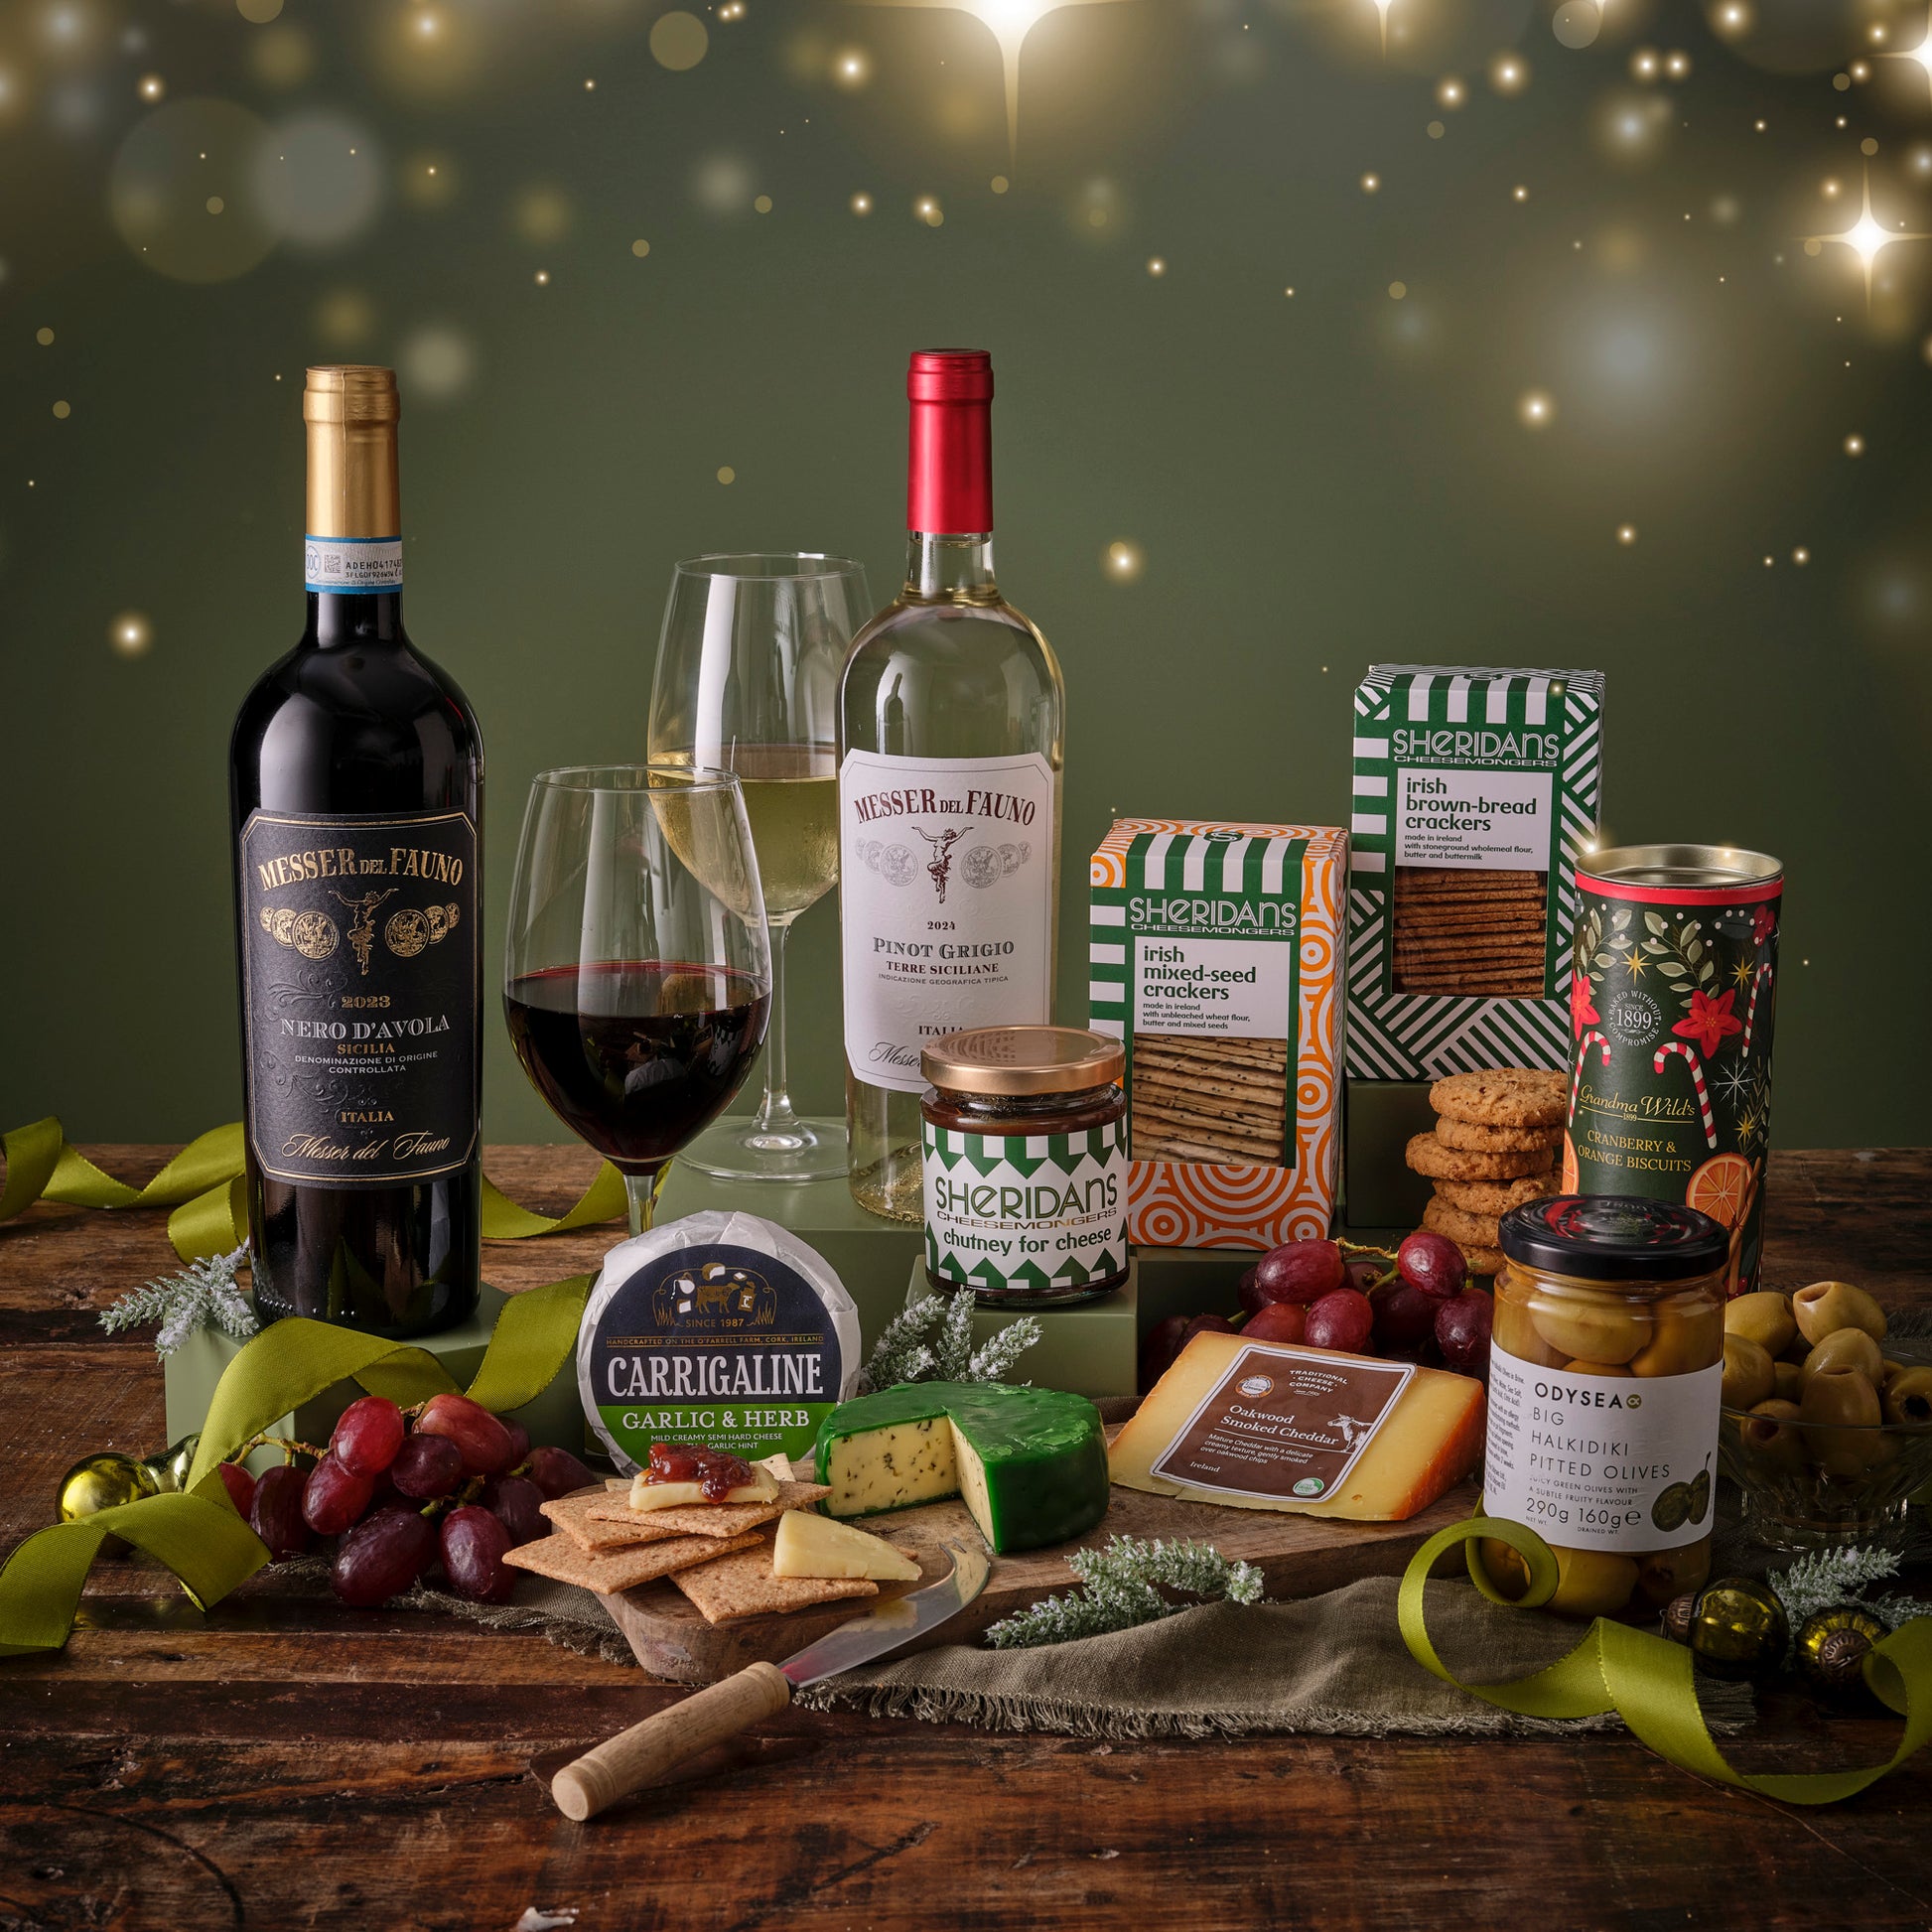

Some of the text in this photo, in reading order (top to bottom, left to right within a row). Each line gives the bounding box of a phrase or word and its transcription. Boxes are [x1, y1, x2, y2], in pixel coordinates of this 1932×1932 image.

[1394, 756, 1558, 767] CHEESEMONGERS
[1406, 776, 1447, 794] irish
[854, 789, 1035, 826] MESSER DEL FAUNO
[1406, 794, 1537, 815] brown-bread
[1405, 813, 1491, 831] crackers
[1423, 843, 1469, 852] stoneground
[257, 847, 463, 891] MESSER DEL FAUNO
[927, 921, 956, 930] 2024
[1131, 923, 1295, 936] CHEESEMONGERS
[873, 937, 1014, 960] PINOT GRIGIO
[1144, 945, 1184, 963] irish
[886, 961, 998, 975] TERRE SICILIANE
[1144, 964, 1256, 983] mixed-seed
[878, 973, 926, 984] INDICAZIONE
[984, 976, 1009, 984] TIPICA
[1143, 982, 1230, 1000] crackers
[341, 995, 391, 1008] 2023
[1631, 990, 1662, 1021] WITHOUT
[280, 1014, 450, 1039] NERO D'AVOLA
[1617, 1009, 1652, 1030] 1899
[1609, 1022, 1659, 1046] COMPROMISE
[295, 1055, 382, 1065] DENOMINAZIONE
[399, 1051, 438, 1062] ORIGINE
[337, 1043, 396, 1055] SICILIA
[869, 1041, 921, 1068] Messe
[329, 1065, 407, 1074] CONTROLLATA
[1580, 1084, 1696, 1116] Grandma Wild's
[341, 1111, 395, 1122] ITALIA
[281, 1130, 450, 1160] Messer del Fauno
[1587, 1129, 1677, 1153] CRANBERRY &
[1578, 1145, 1692, 1172] ORANGE BISCUITS
[937, 1207, 1117, 1230] CHEESEMONGERS
[943, 1228, 1111, 1256] chutney for cheese
[685, 1317, 745, 1328] SINCE 1987
[607, 1337, 663, 1346] HANDCRAFTED
[791, 1334, 824, 1343] IRELAND
[608, 1354, 824, 1397] CARRIGALINE
[1289, 1370, 1348, 1384] TRADITIONAL
[1297, 1376, 1334, 1386] CHEESE
[1289, 1381, 1334, 1393] COMPANY
[1534, 1382, 1623, 1409] ODYSEA
[622, 1410, 810, 1430] GARLIC & HERB
[1230, 1405, 1295, 1424] Oakwood
[1533, 1407, 1565, 1426] BIG
[1220, 1415, 1339, 1445] Smoked Cheddar
[1204, 1440, 1231, 1450] creamy
[1257, 1451, 1280, 1461] gently
[1280, 1454, 1309, 1464] smoked
[1208, 1434, 1234, 1444] Mature
[1234, 1439, 1263, 1450] Cheddar
[1285, 1449, 1313, 1458] delicate
[1531, 1430, 1629, 1457] HALKIDIKI
[1216, 1449, 1248, 1460] oakwood
[1248, 1454, 1268, 1465] chips
[1530, 1453, 1592, 1477] PITTED
[1603, 1464, 1670, 1480] OLIVES
[1190, 1461, 1221, 1473] Ireland
[1536, 1488, 1562, 1500] SUBTLE
[1565, 1494, 1593, 1504] FRUITY
[1553, 1480, 1581, 1490] GREEN
[1584, 1485, 1613, 1494] OLIVES
[1526, 1497, 1569, 1523] 290g
